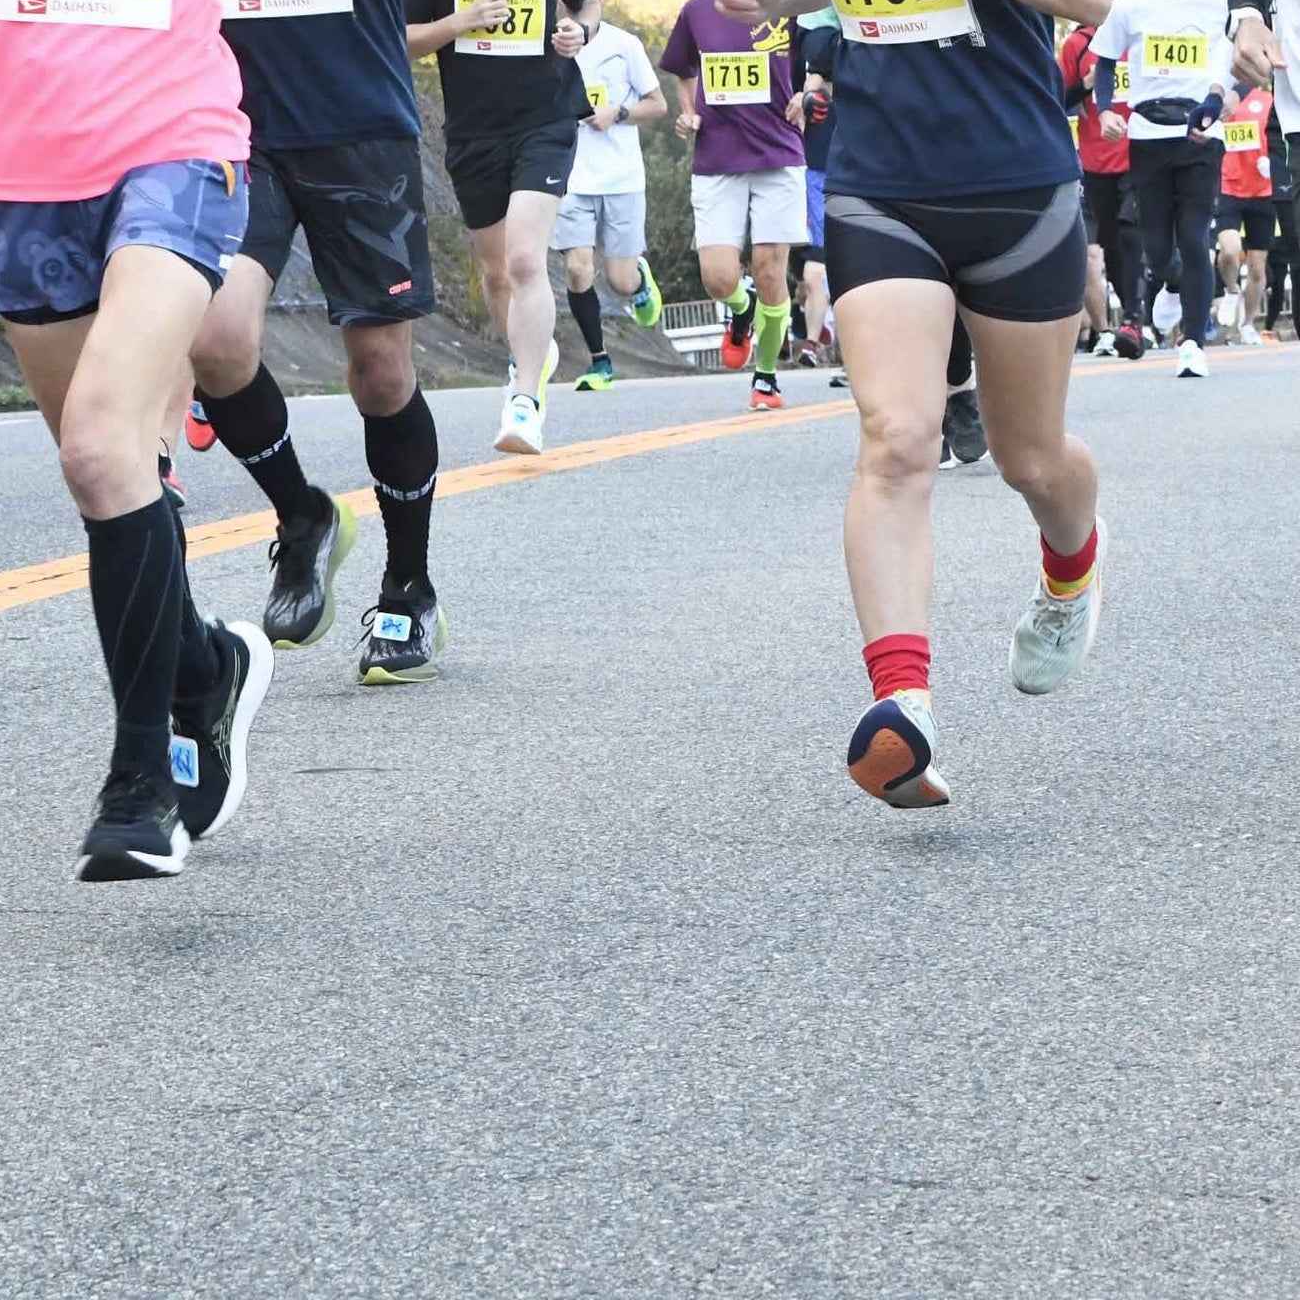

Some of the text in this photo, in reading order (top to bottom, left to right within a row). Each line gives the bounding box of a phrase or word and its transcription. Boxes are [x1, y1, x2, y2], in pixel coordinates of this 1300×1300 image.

[52, 0, 115, 15] DAIHATSU
[880, 21, 928, 34] DAIHATSU
[1153, 43, 1197, 64] 1401
[709, 65, 760, 87] 1715
